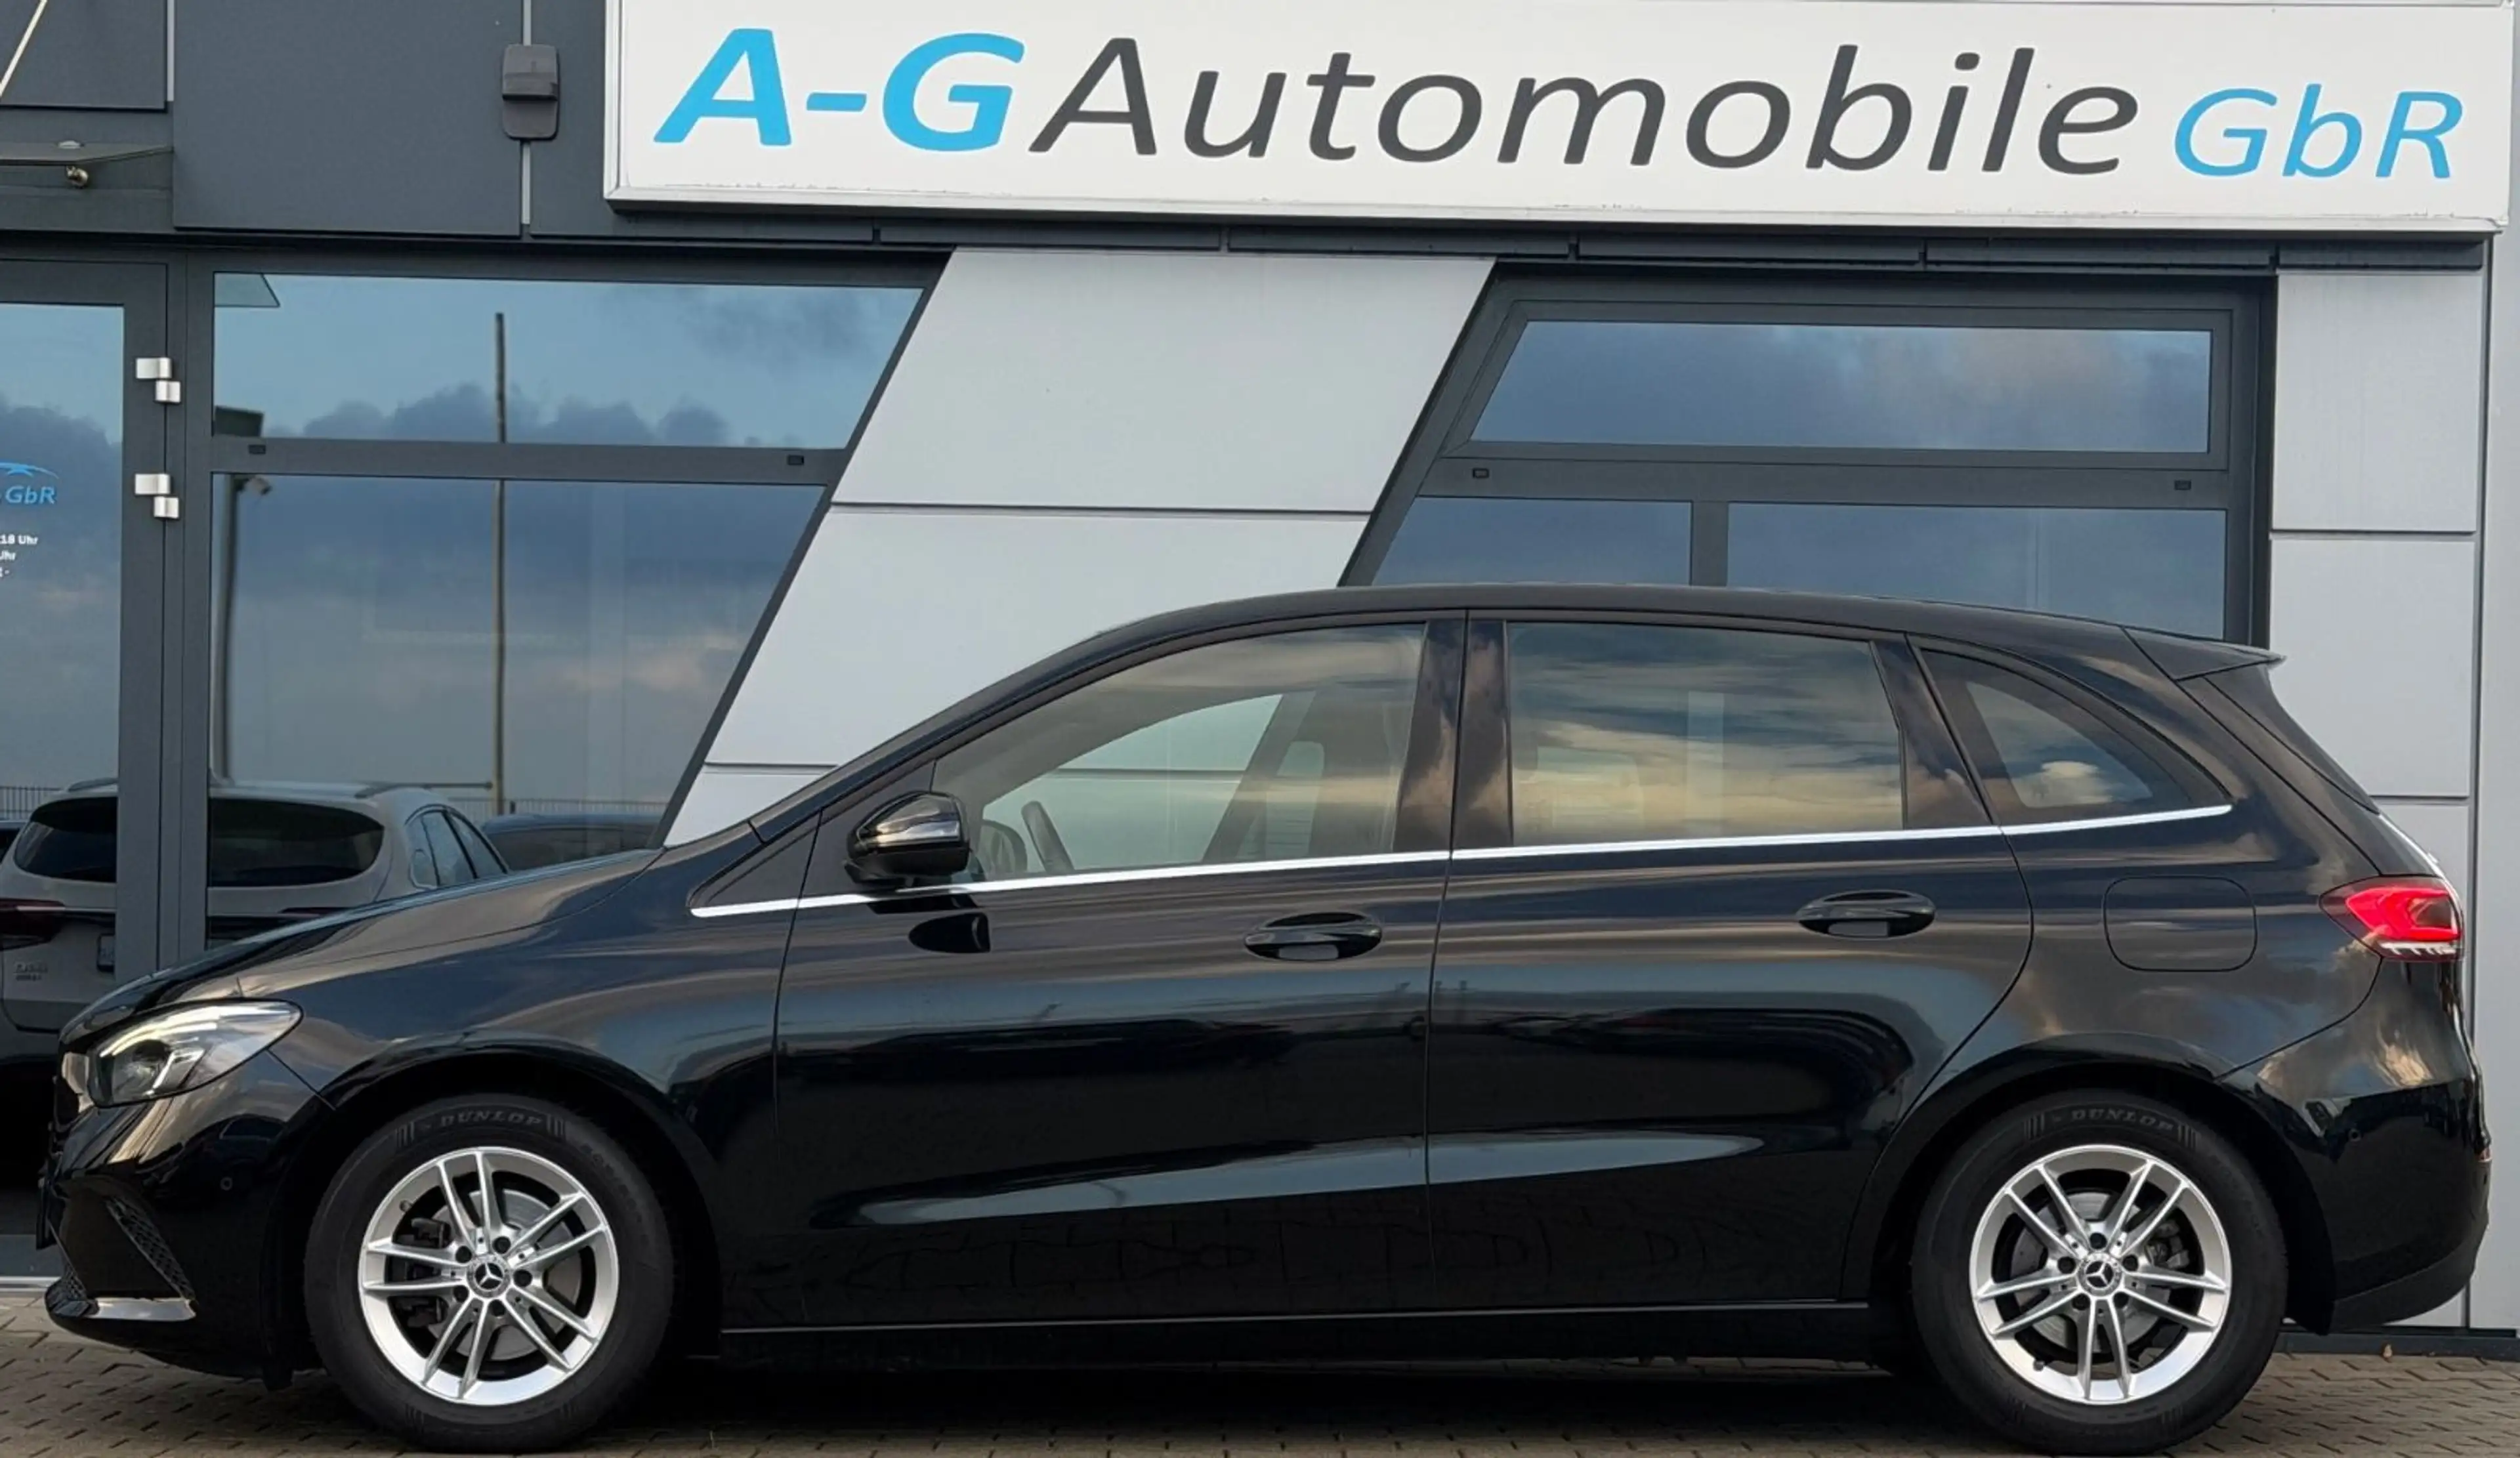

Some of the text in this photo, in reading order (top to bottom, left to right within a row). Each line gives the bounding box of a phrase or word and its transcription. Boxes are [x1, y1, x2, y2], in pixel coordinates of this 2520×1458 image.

[654, 28, 2464, 178] A-G Automobile GbR
[5, 485, 55, 505] GbR
[18, 535, 39, 545] Uhr
[439, 1110, 543, 1127] DUNLOP
[2071, 1108, 2174, 1130] DUNLOP
